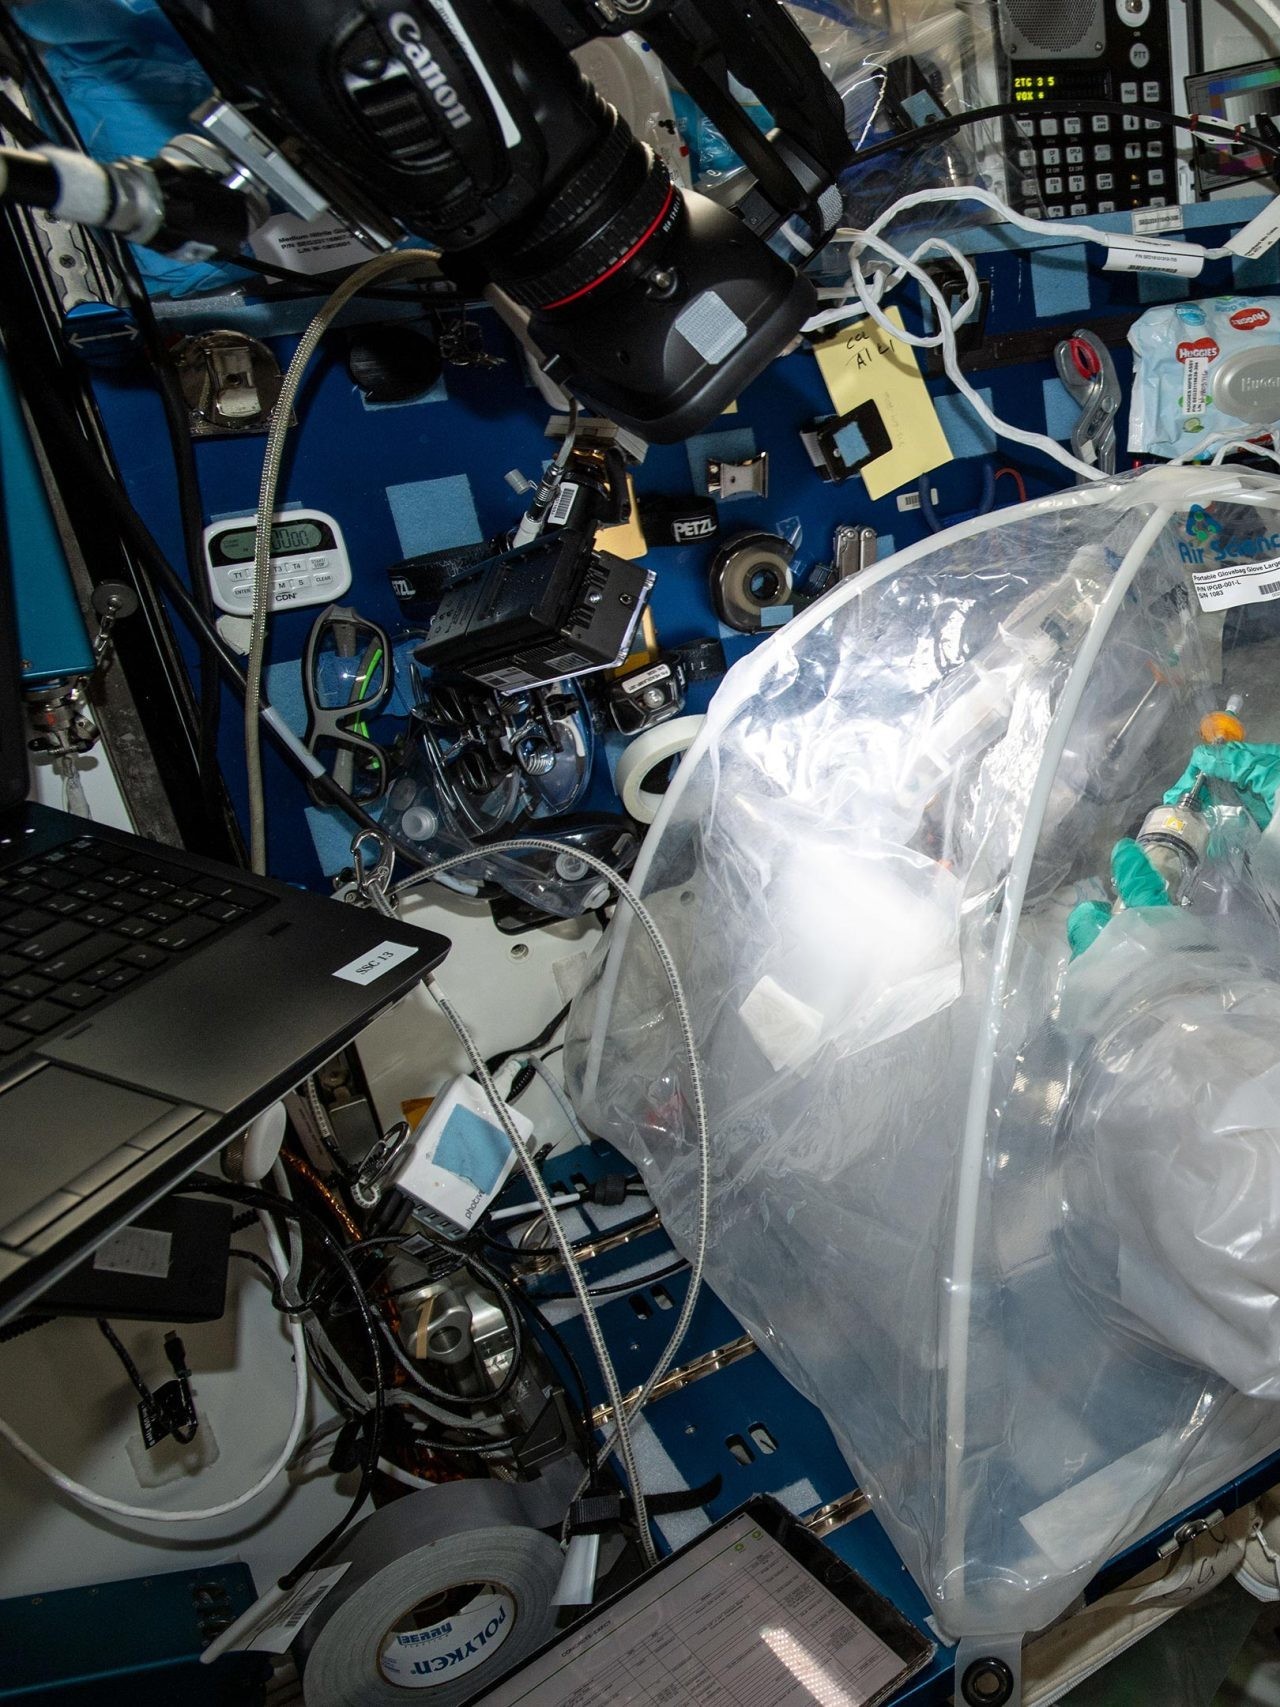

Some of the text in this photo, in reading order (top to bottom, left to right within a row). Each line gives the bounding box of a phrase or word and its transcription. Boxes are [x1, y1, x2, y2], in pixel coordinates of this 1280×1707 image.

[388, 11, 472, 129] Canon
[1047, 76, 1055, 86] 5
[1179, 347, 1218, 359] HUGGIES
[673, 518, 717, 542] PETZL
[1178, 541, 1204, 564] Air
[1194, 573, 1217, 581] Portable
[1217, 567, 1247, 578] Glovebag
[1247, 565, 1264, 573] Glove
[275, 593, 297, 602] CDN
[355, 951, 394, 975] SSC 13
